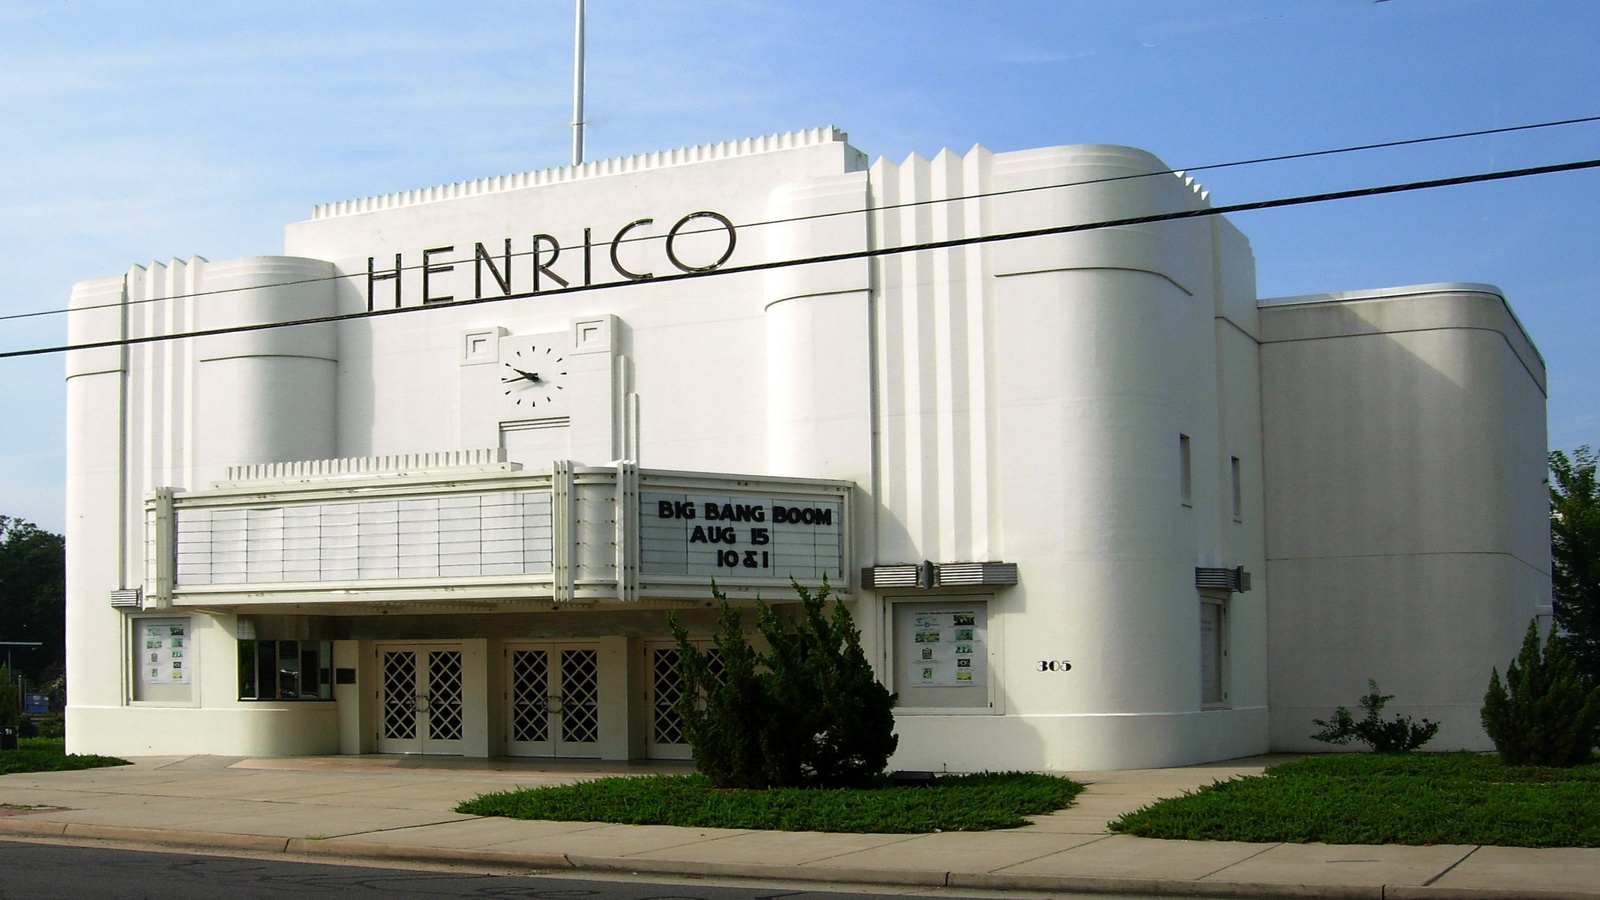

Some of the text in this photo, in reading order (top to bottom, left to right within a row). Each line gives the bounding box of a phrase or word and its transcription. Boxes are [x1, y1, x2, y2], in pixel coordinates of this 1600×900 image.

[367, 210, 737, 312] HENRICO
[658, 500, 832, 525] BIG BANG BOOM
[690, 525, 770, 545] AUG 15
[1036, 660, 1072, 672] 305
